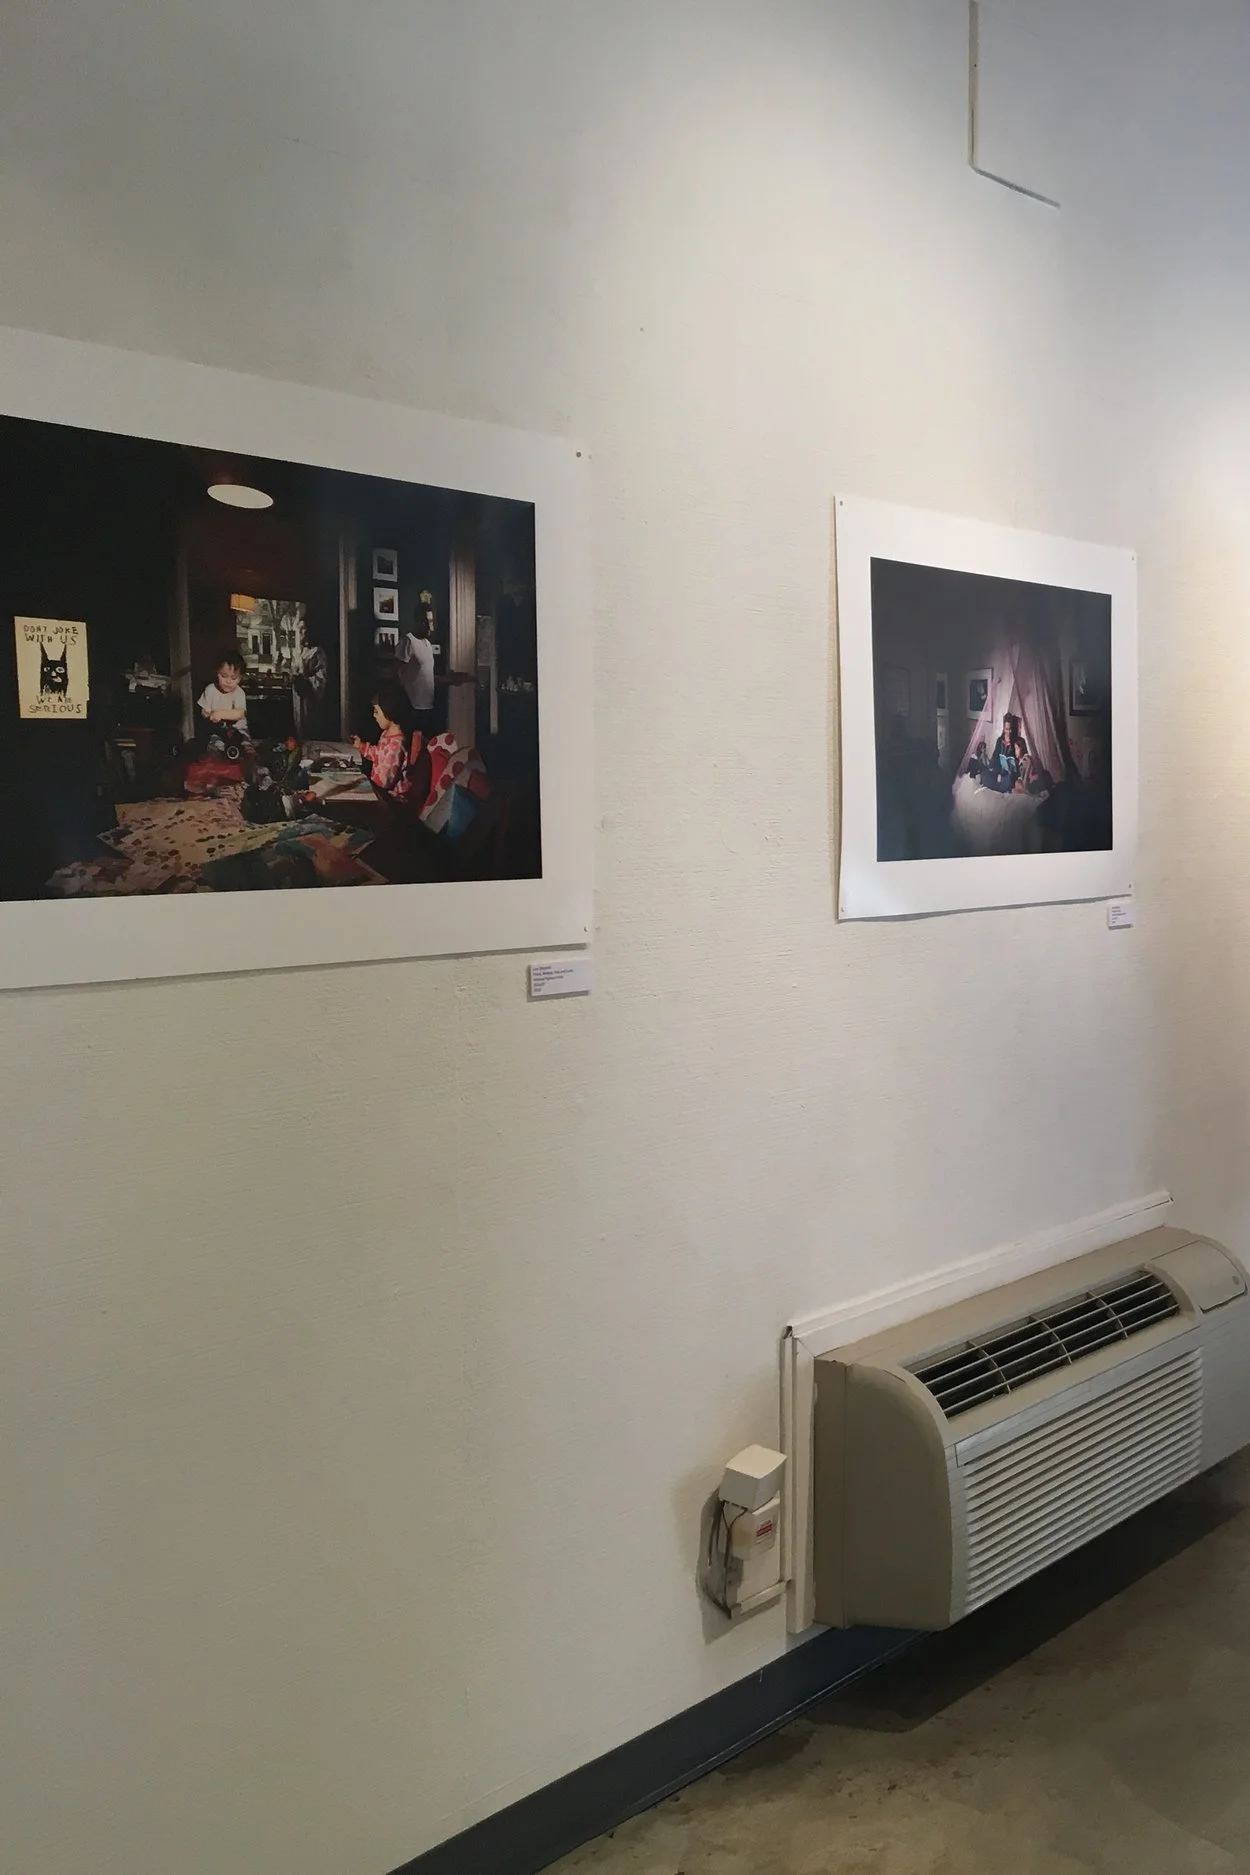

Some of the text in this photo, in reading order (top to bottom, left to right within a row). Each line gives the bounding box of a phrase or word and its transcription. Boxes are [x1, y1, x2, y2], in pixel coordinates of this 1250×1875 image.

[53, 626, 79, 635] JOKE
[25, 633, 77, 646] WITH US
[29, 704, 82, 714] SERIOUS
